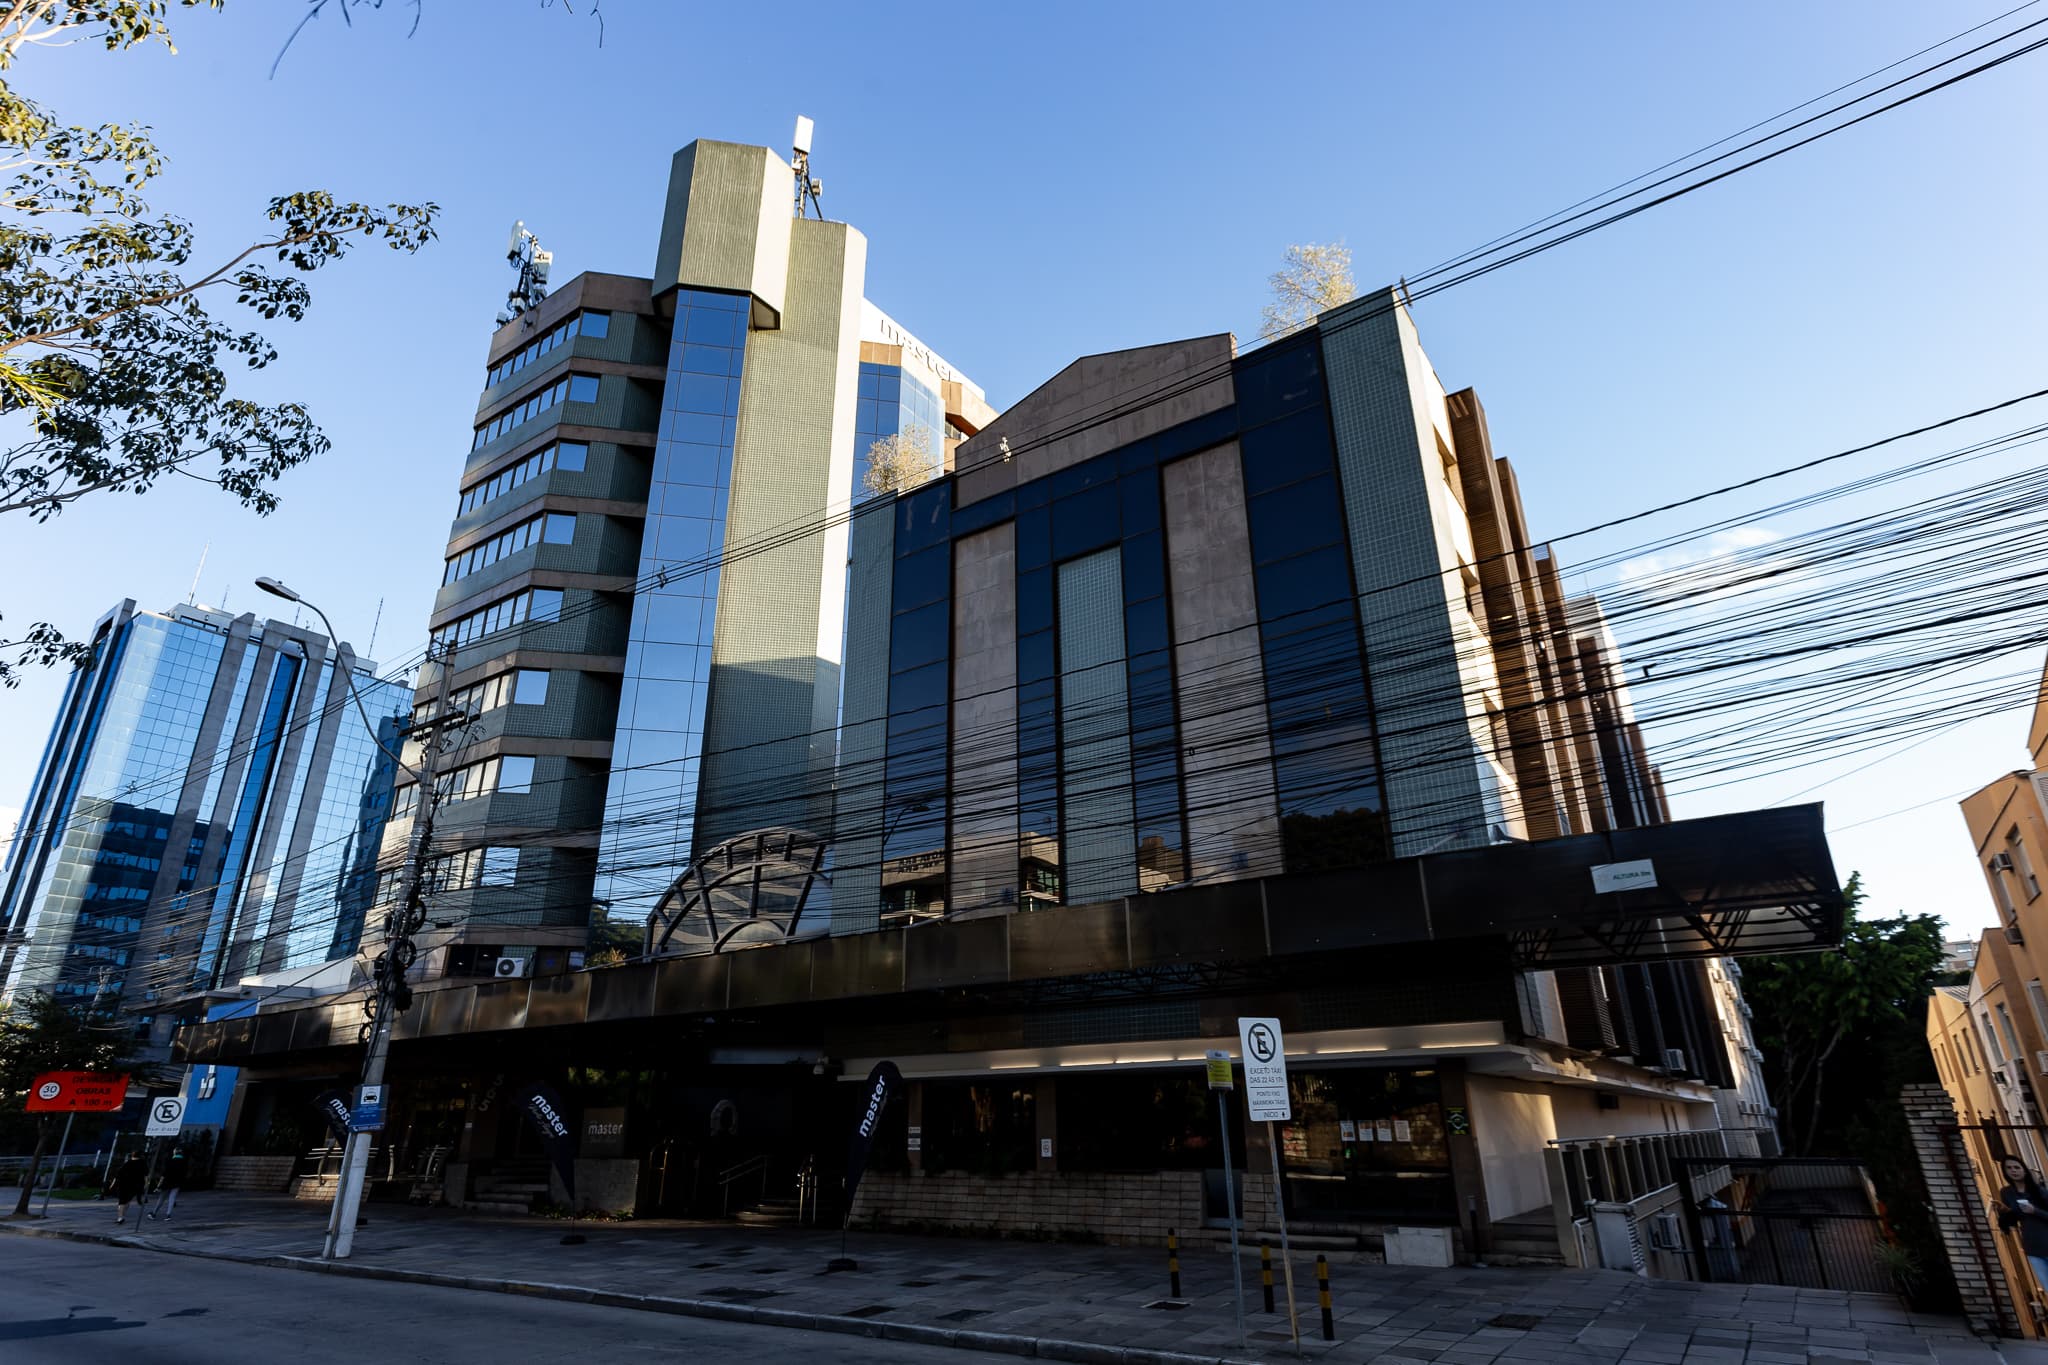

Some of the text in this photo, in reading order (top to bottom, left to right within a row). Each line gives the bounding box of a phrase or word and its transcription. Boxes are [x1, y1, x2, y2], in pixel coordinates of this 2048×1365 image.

[42, 1085, 58, 1094] 30
[75, 1087, 112, 1095] OBRAS
[859, 1074, 886, 1138] master
[531, 1095, 568, 1136] master
[587, 1122, 624, 1136] master
